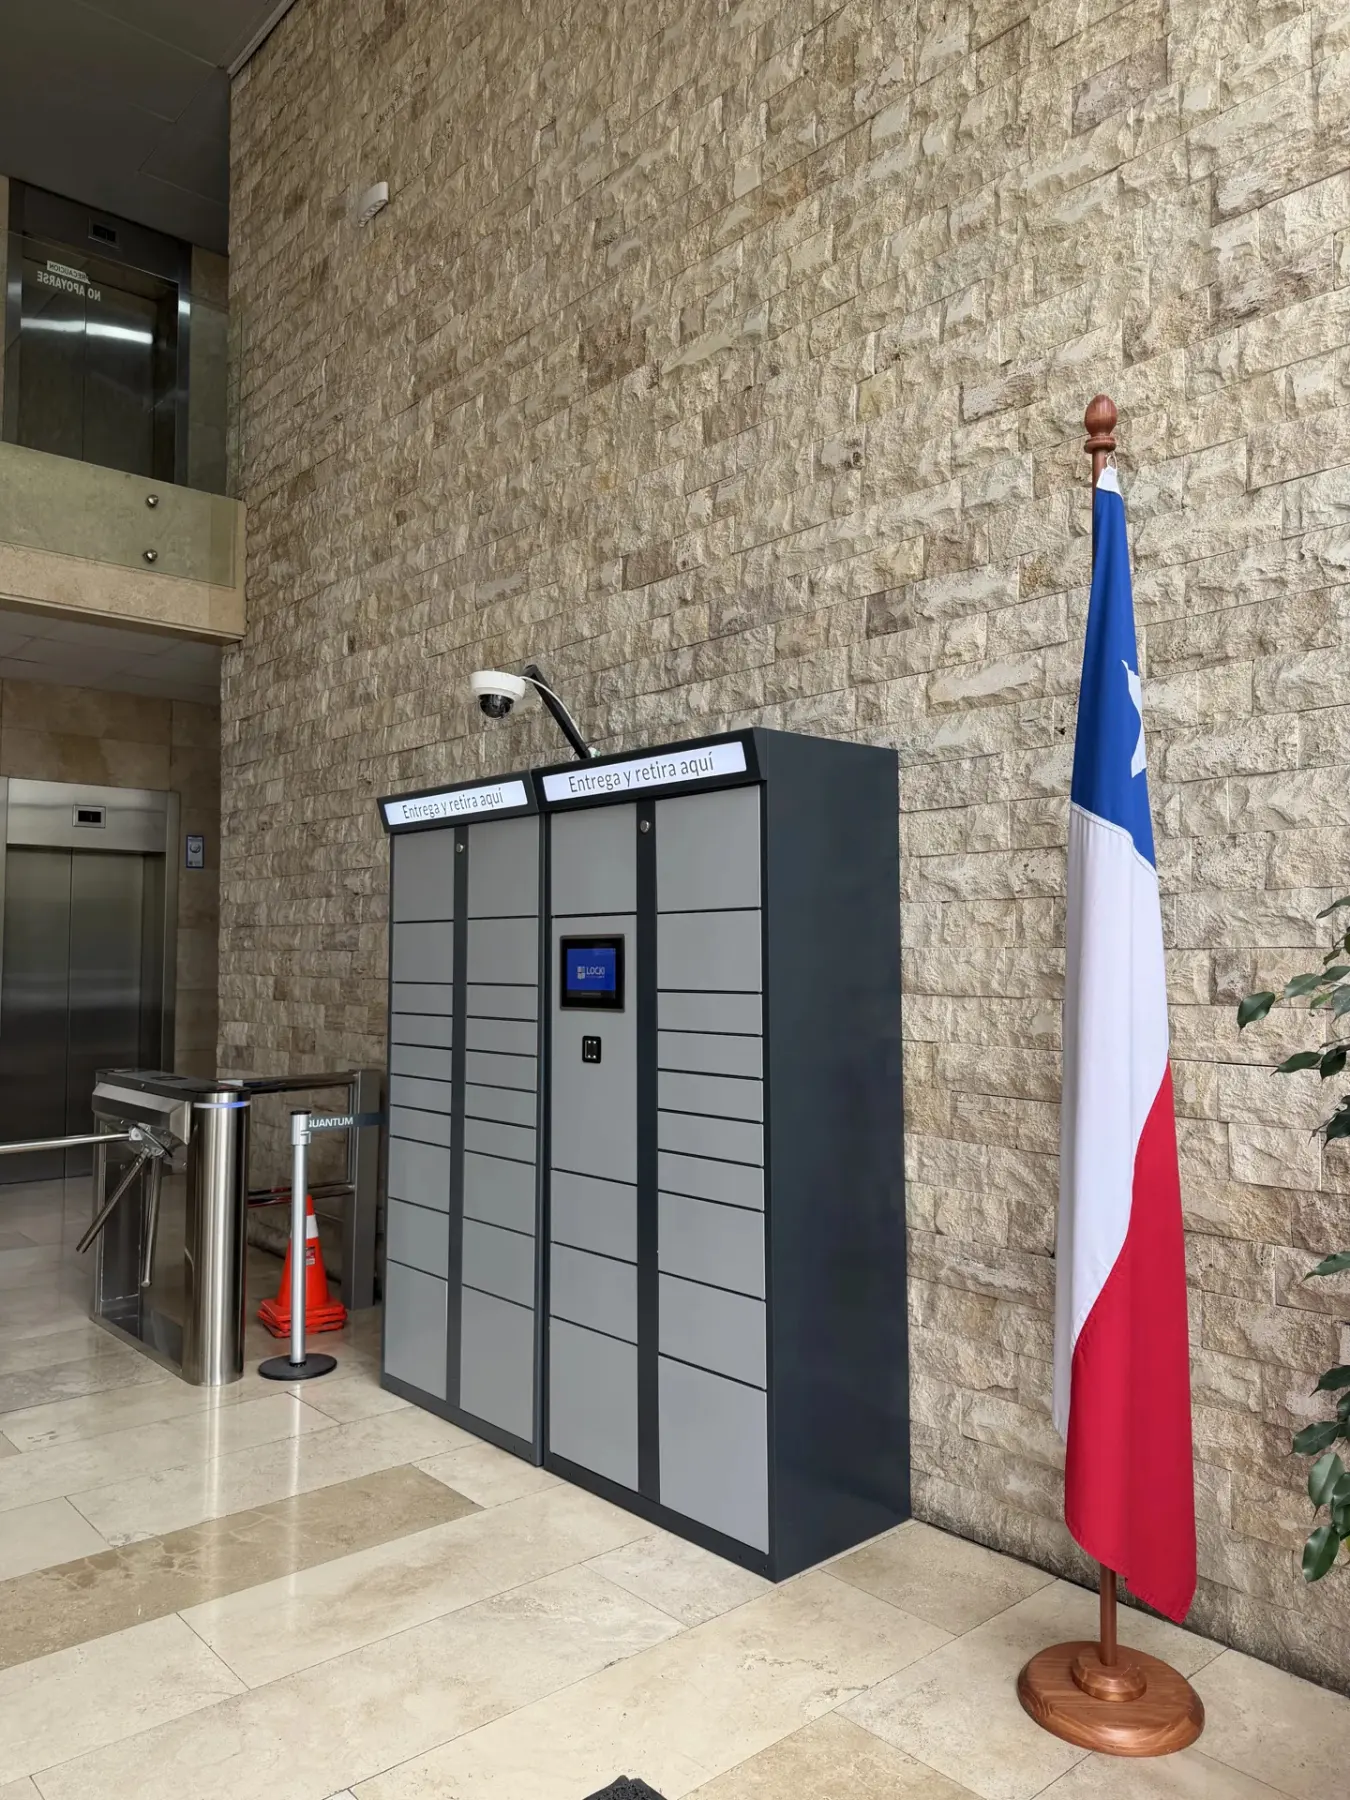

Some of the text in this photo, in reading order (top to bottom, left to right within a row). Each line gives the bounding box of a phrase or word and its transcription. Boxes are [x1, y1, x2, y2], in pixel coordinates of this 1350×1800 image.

[569, 751, 714, 793] Entrega y retira aquí
[402, 788, 504, 819] Entrega y retira aquí
